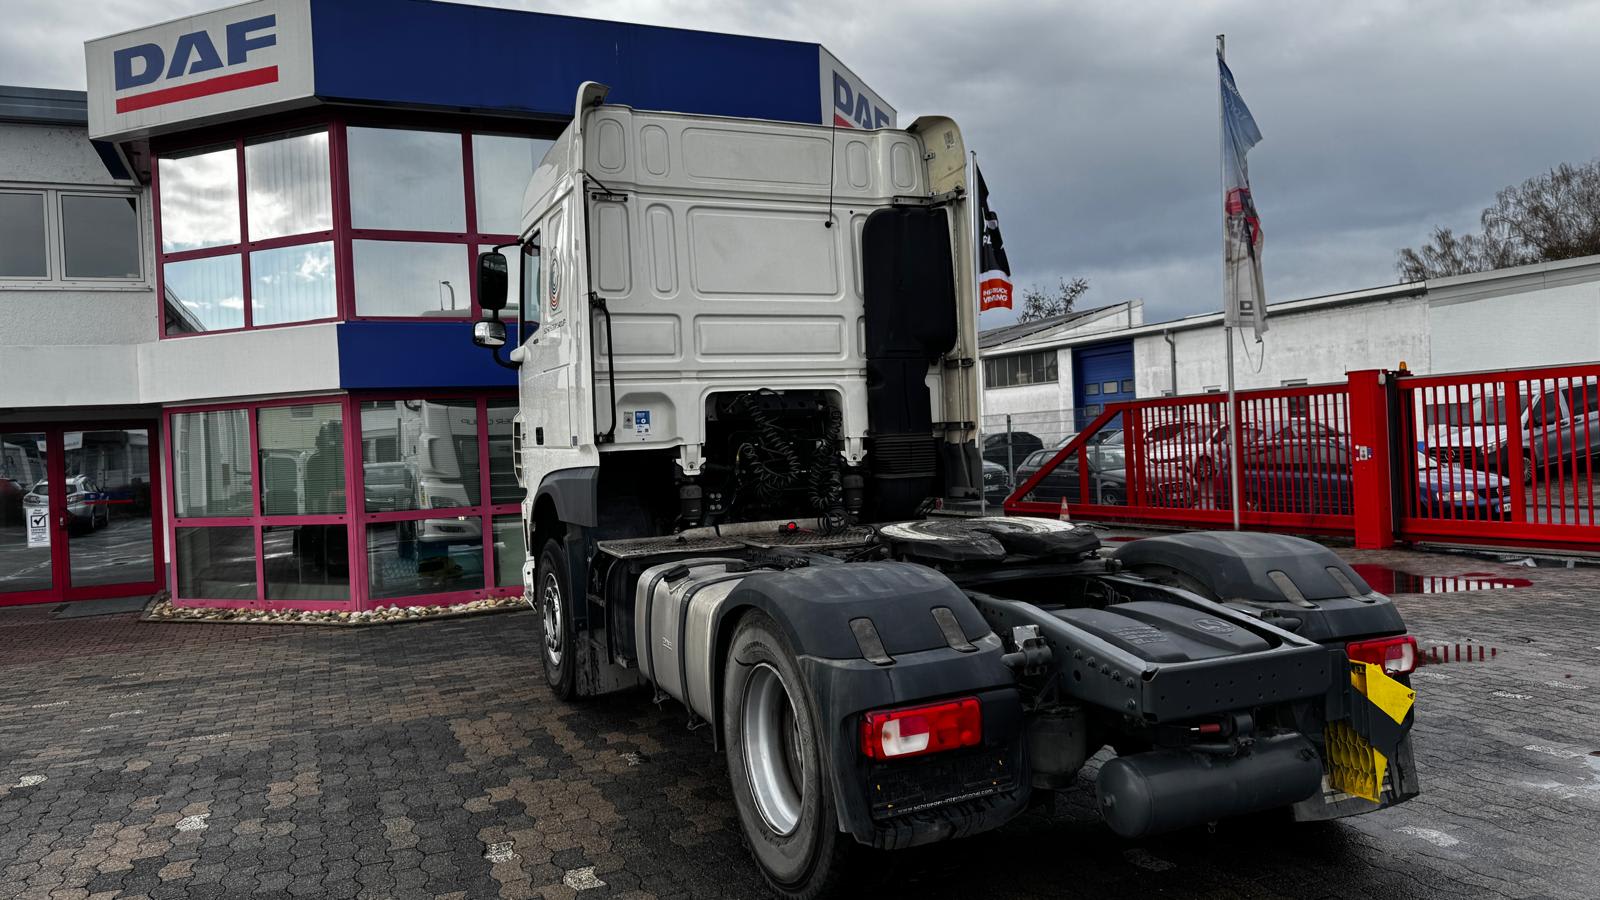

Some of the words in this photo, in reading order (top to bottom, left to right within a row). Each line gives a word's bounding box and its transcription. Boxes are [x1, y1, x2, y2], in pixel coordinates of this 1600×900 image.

[113, 14, 277, 91] DAF
[832, 70, 890, 129] DAF
[897, 788, 994, 813] www.schroeder-international.com
